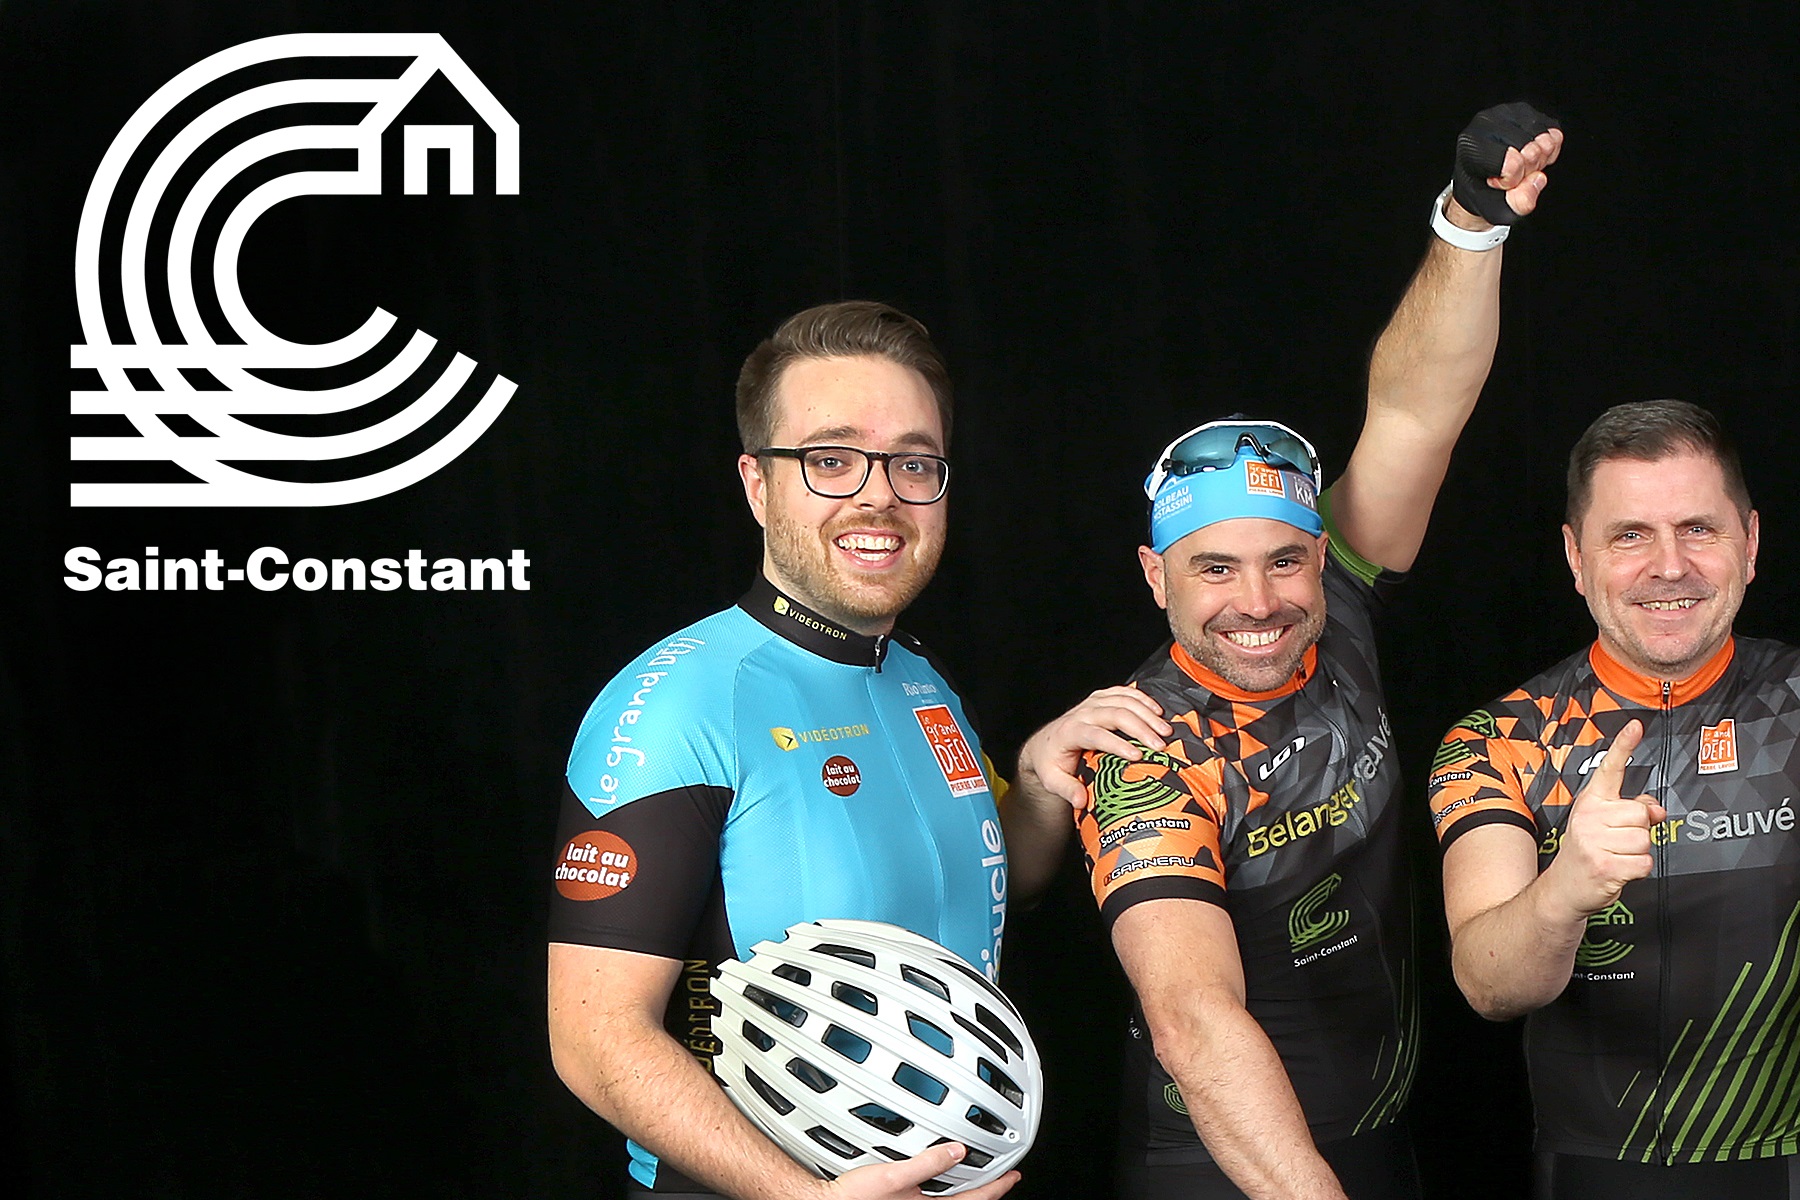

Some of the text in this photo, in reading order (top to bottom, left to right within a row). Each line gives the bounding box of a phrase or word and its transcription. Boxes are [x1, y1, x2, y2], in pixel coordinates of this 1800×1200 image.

[1295, 484, 1314, 508] KM
[606, 671, 669, 767] grand
[823, 774, 862, 788] chocolat
[826, 764, 855, 776] lait au
[1100, 817, 1191, 849] Saint-Constant
[566, 842, 629, 869] lait au
[1110, 855, 1194, 880] GARNEAU
[554, 865, 631, 889] chocolat
[1293, 934, 1359, 969] Saint-Constant
